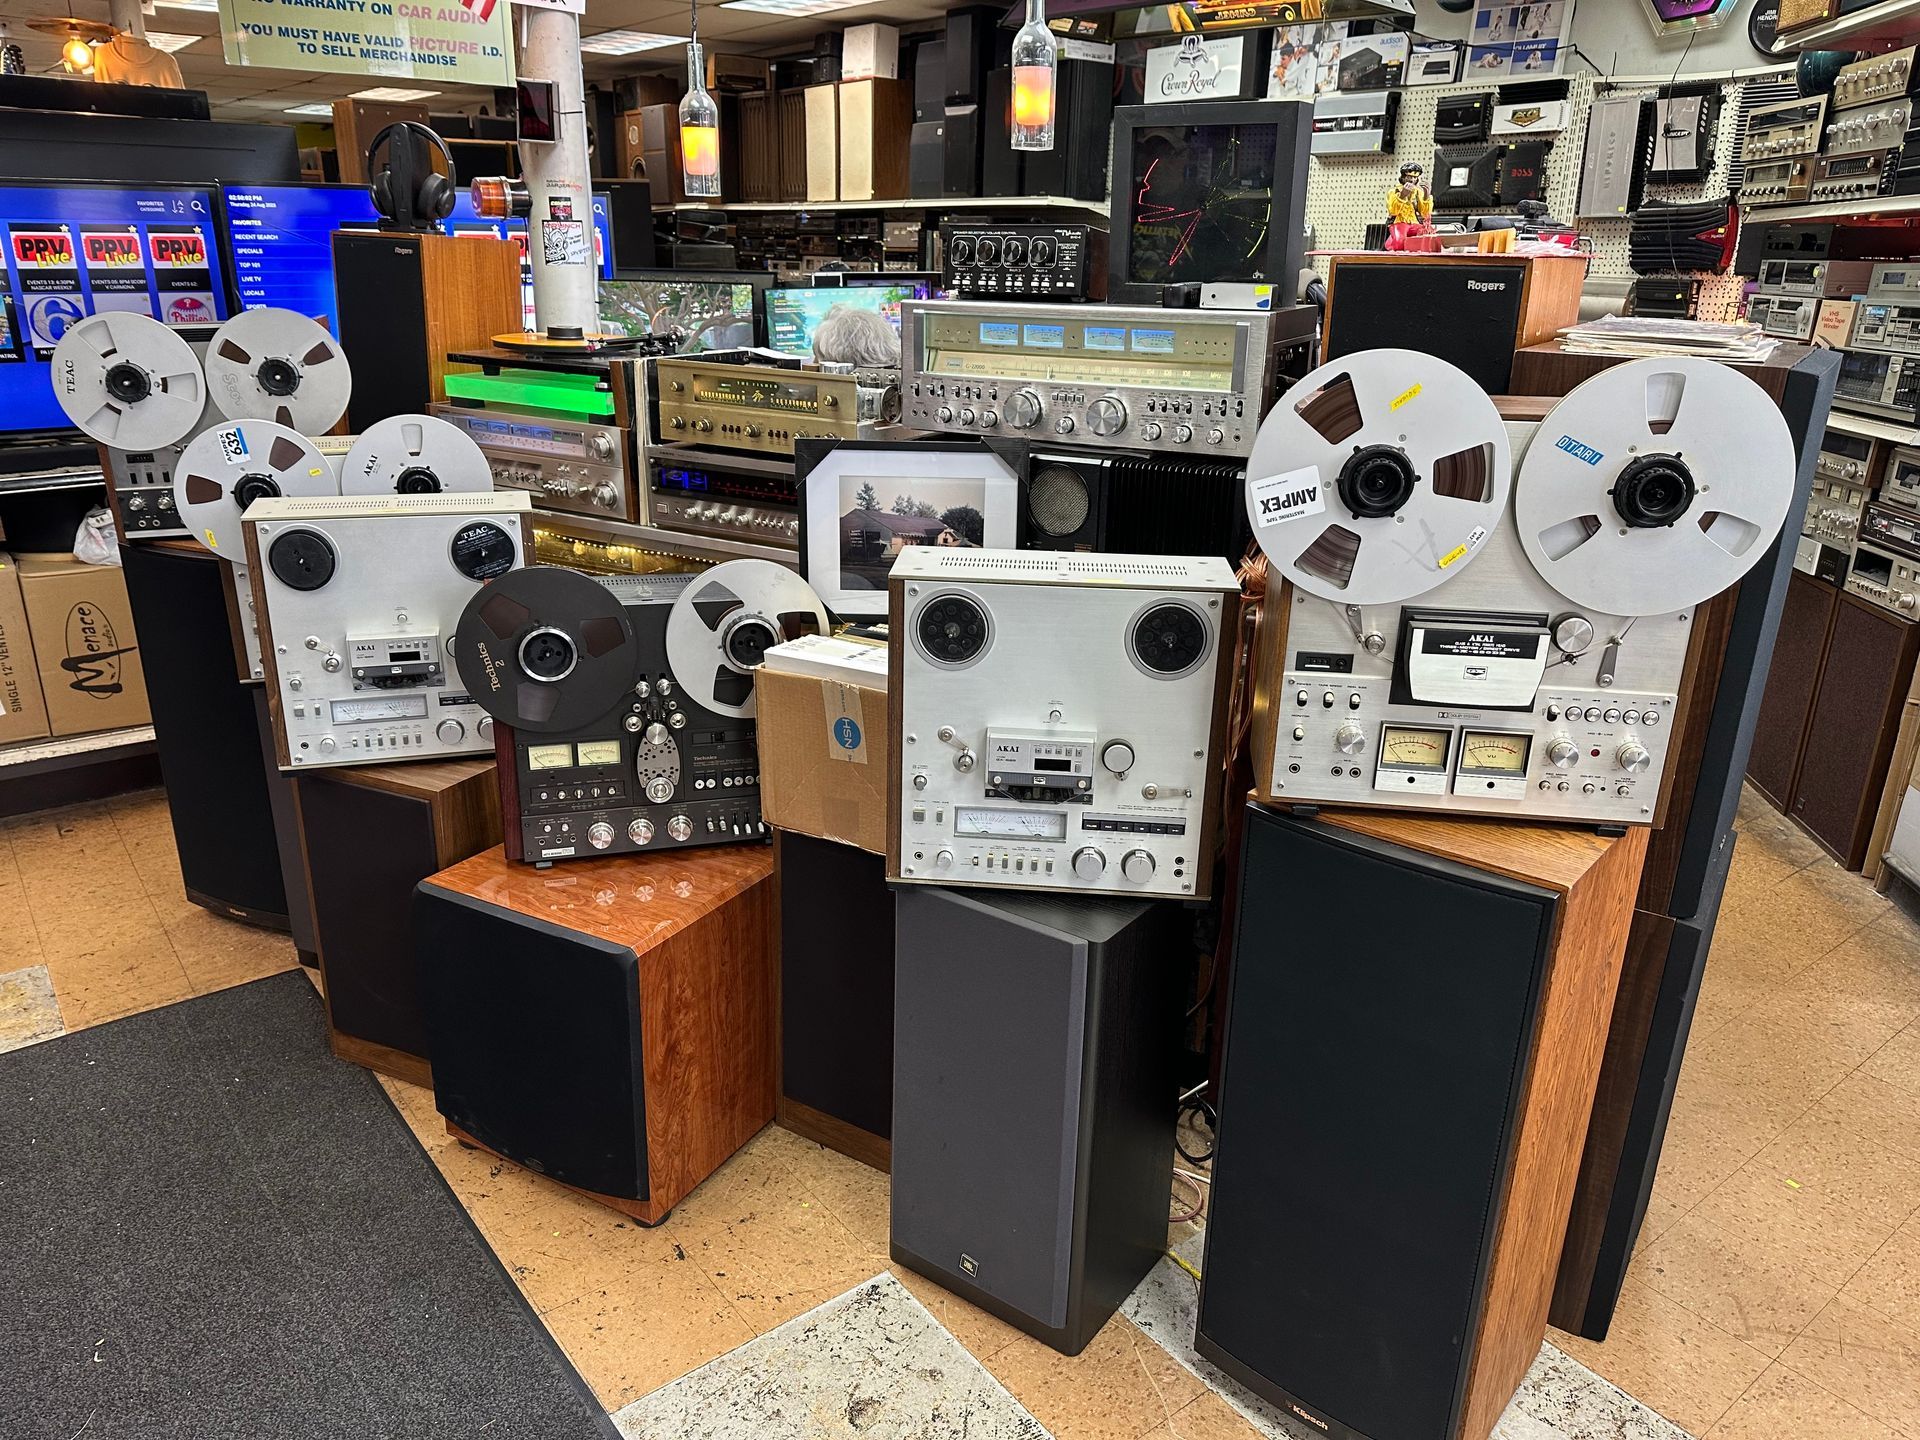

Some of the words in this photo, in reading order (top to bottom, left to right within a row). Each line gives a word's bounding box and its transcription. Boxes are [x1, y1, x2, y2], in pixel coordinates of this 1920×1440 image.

[370, 3, 393, 15] ON
[398, 3, 432, 19] CAR
[241, 23, 273, 36] YOU
[278, 26, 318, 40] MUST
[323, 31, 360, 43] HAVE
[364, 34, 404, 48] VALID
[410, 36, 478, 54] PICTURE
[482, 45, 503, 57] I.D.
[297, 42, 317, 54] TO
[321, 44, 356, 57] SELL
[360, 48, 457, 66] MERCHANDISE
[1161, 72, 1188, 96] Crown
[1181, 69, 1221, 94] Royal
[1511, 168, 1534, 177] BOSS
[19, 238, 65, 259] PPV
[36, 251, 70, 268] Live
[89, 238, 131, 259] PPV
[105, 251, 138, 268] Live
[155, 239, 199, 259] PPV
[171, 251, 202, 268] Live
[1467, 279, 1506, 292] Rogers
[166, 311, 209, 322] Phillies
[65, 360, 76, 395] TEAC
[219, 433, 232, 462] AMPEX
[225, 430, 243, 456] 632
[1557, 436, 1601, 464] OTARI
[363, 454, 379, 477] AKAI
[1259, 486, 1317, 515] AMPEX
[1278, 509, 1305, 521] MASTERING
[461, 525, 488, 539] TEAC
[61, 606, 138, 693] Menace
[1469, 635, 1494, 643] AKAI
[477, 642, 501, 692] Technics
[12, 679, 23, 713] SINGLE
[841, 718, 853, 748] HSN
[996, 745, 1020, 753] AKAI
[1292, 1404, 1329, 1431] Klipsch
